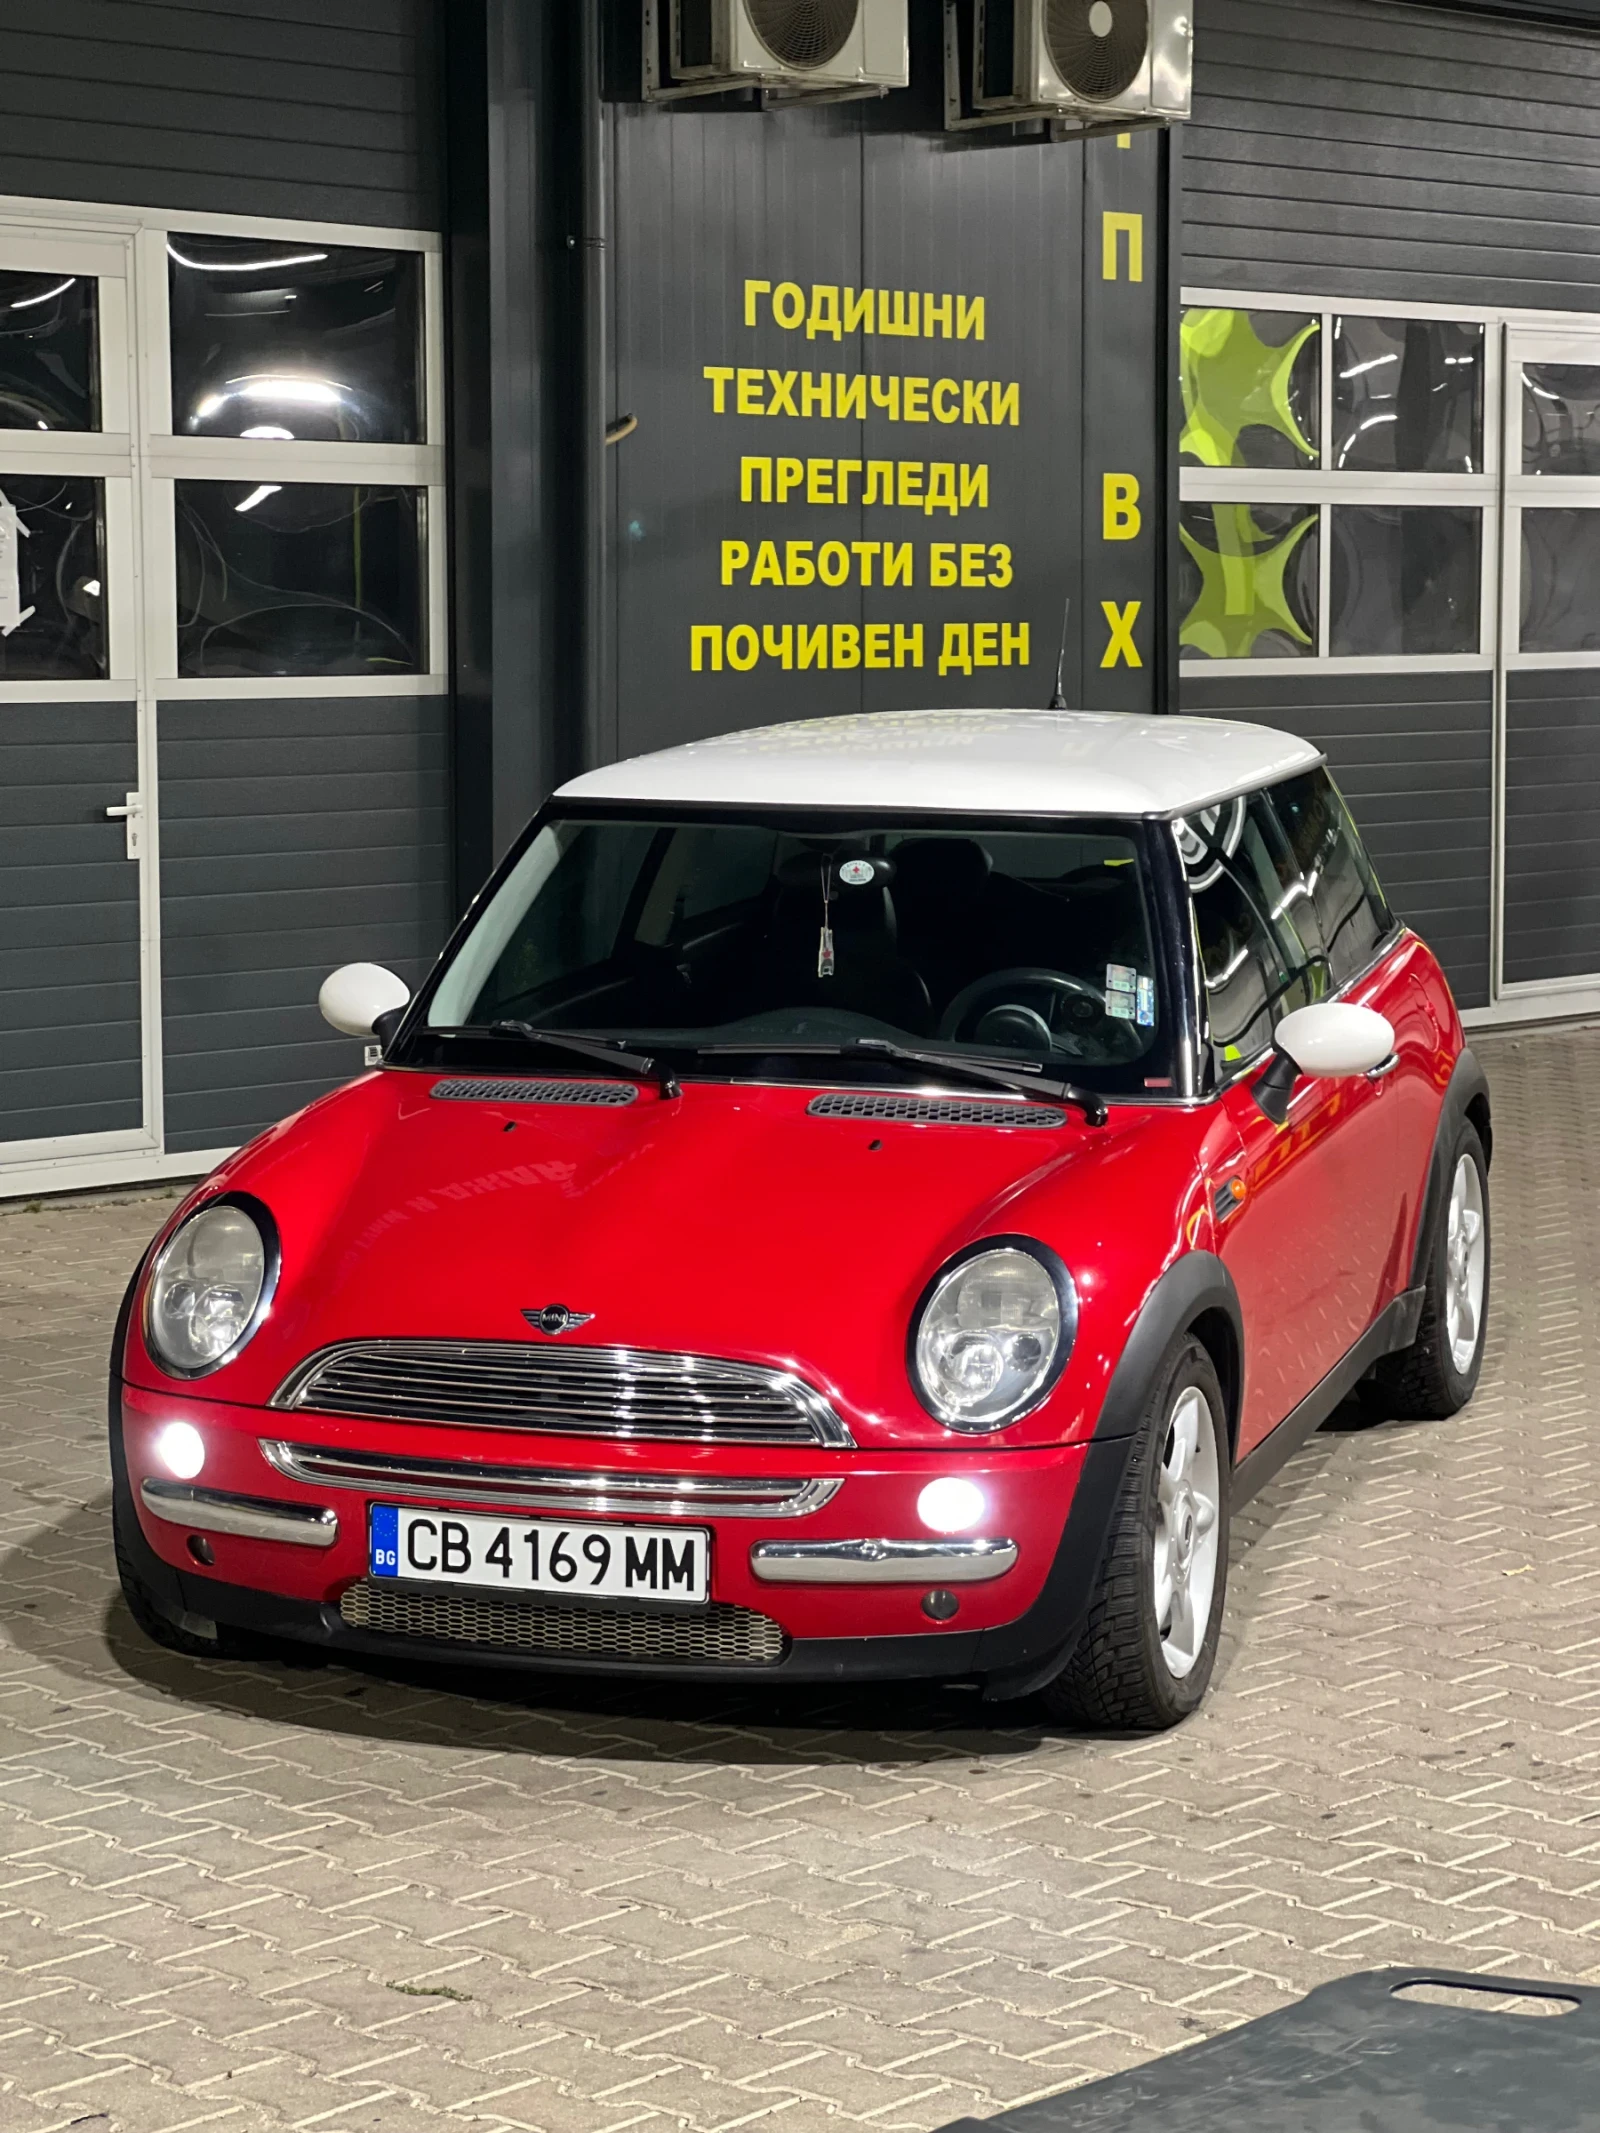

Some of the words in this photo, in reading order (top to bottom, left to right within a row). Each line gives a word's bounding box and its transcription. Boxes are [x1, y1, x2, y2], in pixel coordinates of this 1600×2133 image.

[744, 279, 986, 341] ГОДИШНИ
[702, 366, 1020, 427] ТЕХНИЧЕСКИ
[740, 455, 989, 517] ПРЕГЛЕДИ
[720, 539, 914, 588] РАБОТИ
[929, 542, 1014, 589] БЕЗ
[690, 622, 924, 672] ПОЧИВЕН
[937, 622, 1030, 677] ДЕН
[542, 1312, 567, 1323] MINI
[375, 1548, 396, 1566] BG
[407, 1518, 472, 1574] CB
[485, 1526, 611, 1585] 4169
[625, 1536, 695, 1592] MM
